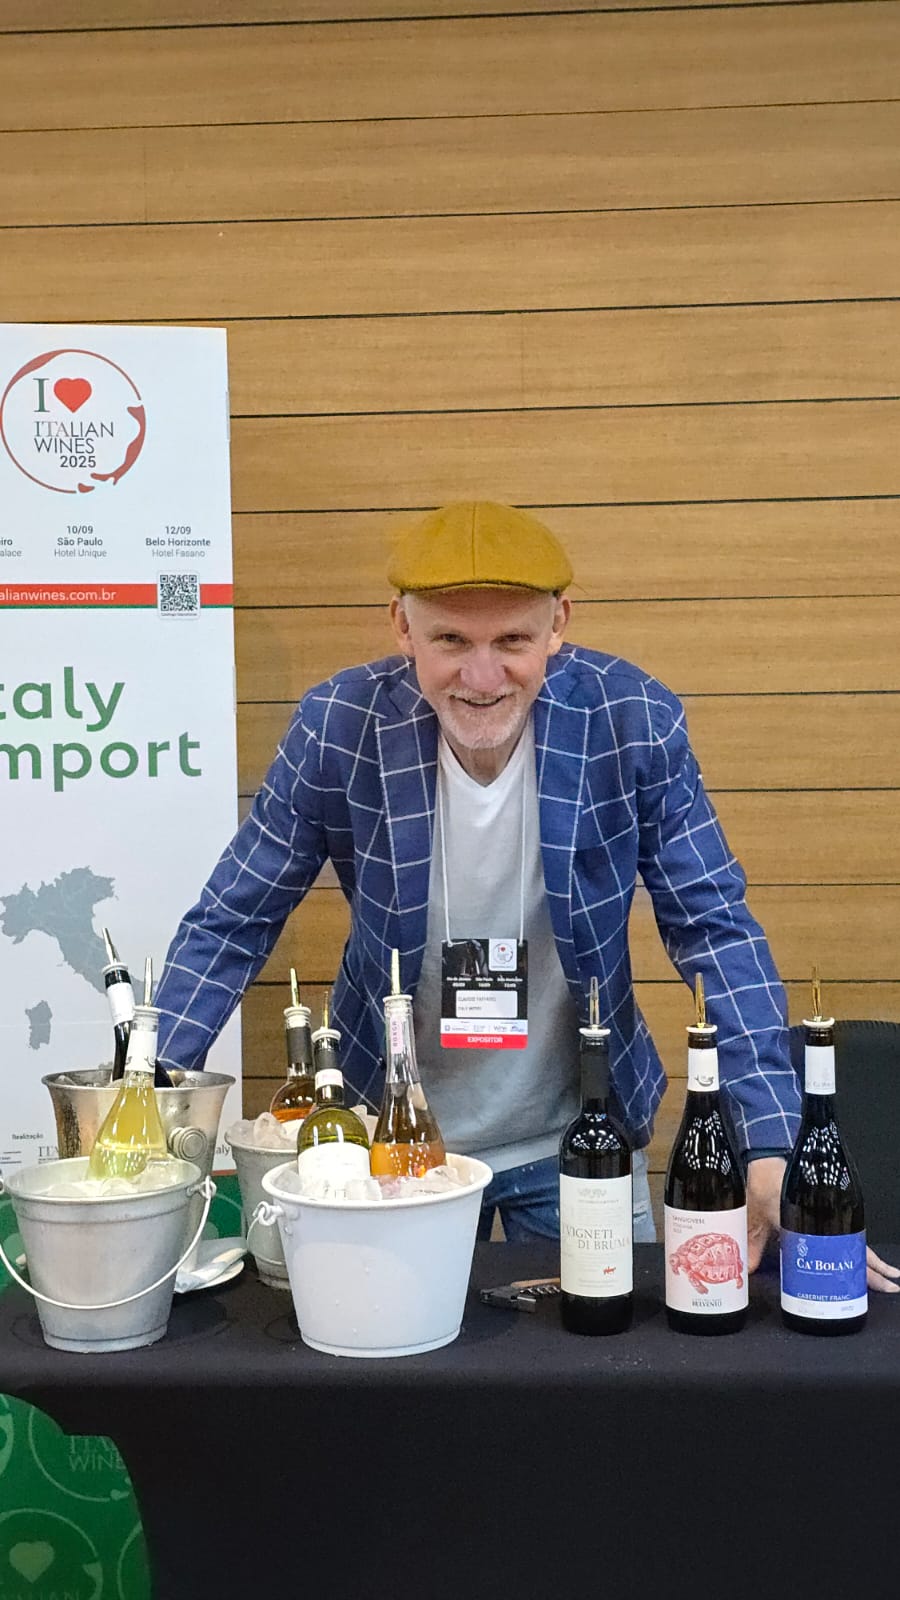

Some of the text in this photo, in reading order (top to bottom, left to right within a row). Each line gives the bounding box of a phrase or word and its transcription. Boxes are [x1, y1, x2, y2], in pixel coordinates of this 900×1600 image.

[33, 378, 50, 412] I
[34, 421, 114, 437] ITALIAN
[34, 438, 95, 454] WINES
[60, 456, 96, 468] 2025
[67, 525, 94, 535] 10/09
[165, 526, 192, 535] 12/09
[57, 537, 103, 546] São Paulo
[145, 538, 211, 546] Belo Horizonte
[54, 549, 107, 559] Hotel Unique
[152, 549, 205, 557] Hotel Fasano
[566, 1225, 613, 1239] VIGNETI
[578, 1239, 590, 1250] DI
[797, 1292, 829, 1301] CABERNET
